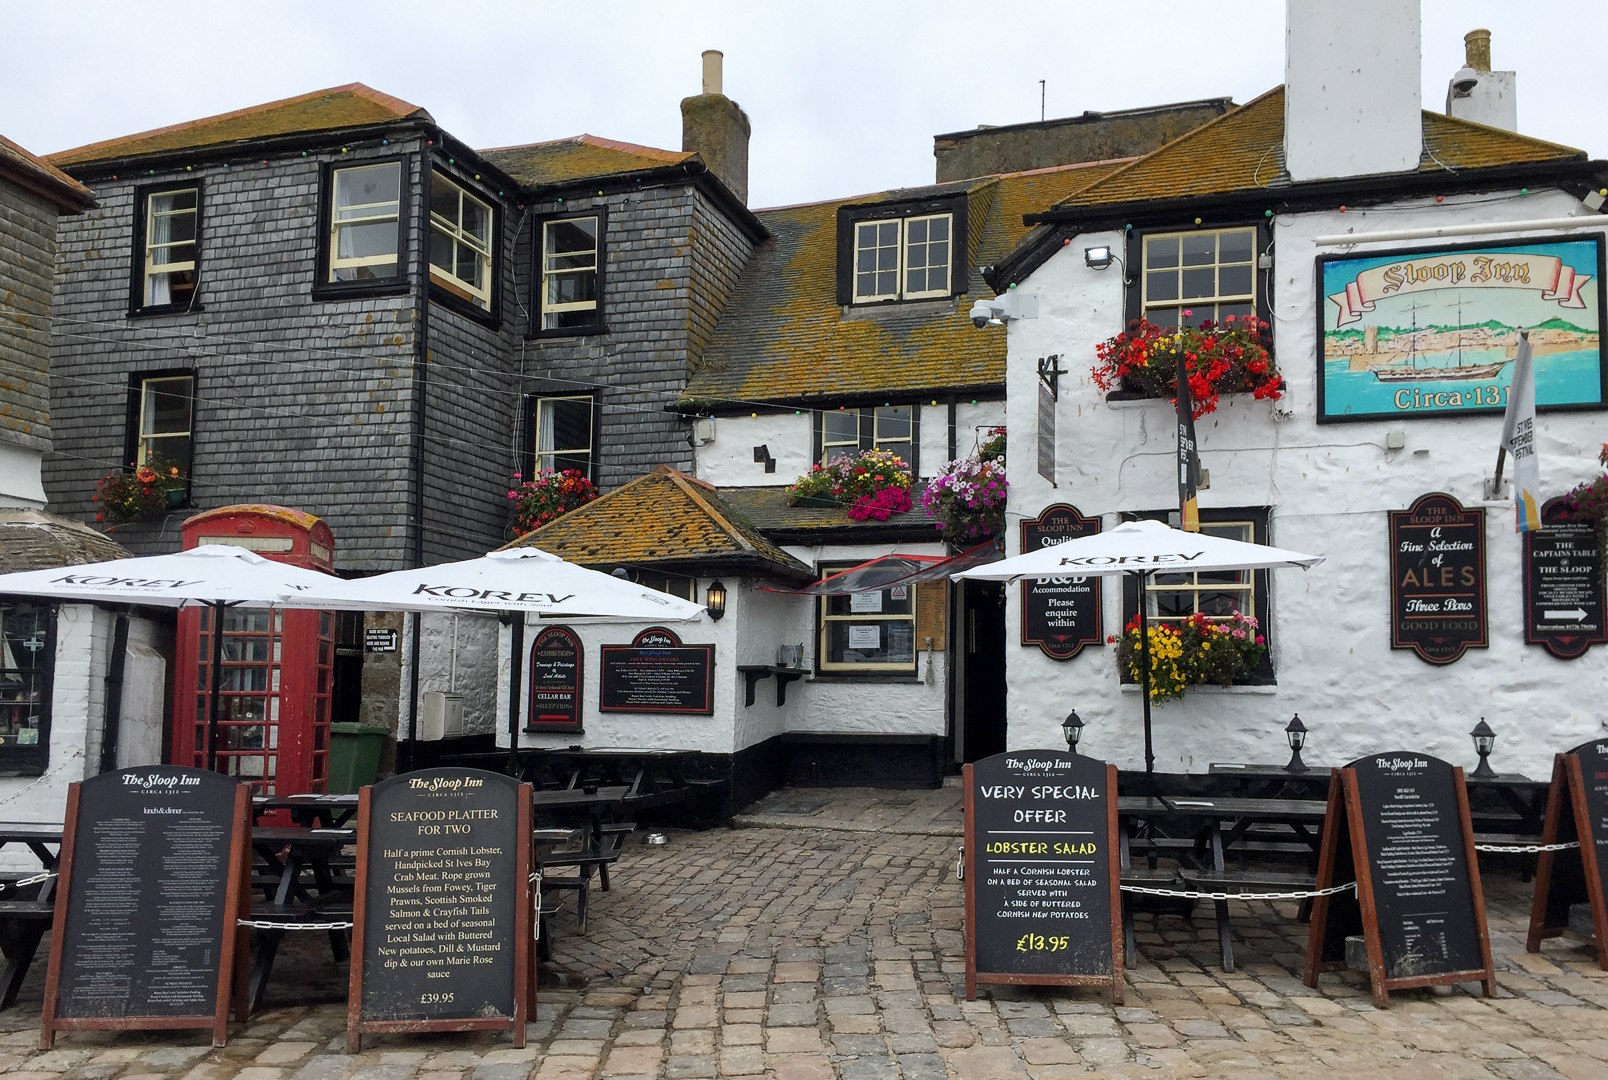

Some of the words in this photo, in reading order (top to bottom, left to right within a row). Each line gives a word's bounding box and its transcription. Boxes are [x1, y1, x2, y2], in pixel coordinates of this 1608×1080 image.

[1383, 257, 1466, 294] Sloop
[1471, 256, 1531, 284] Inn
[1427, 507, 1447, 515] THE
[1410, 516, 1442, 524] SLOOP
[1430, 527, 1441, 538] A
[1400, 541, 1424, 552] Fine
[1428, 540, 1474, 551] Selection
[1059, 551, 1205, 566] KOREV
[1431, 554, 1444, 567] of
[48, 574, 206, 588] KOREV
[1401, 566, 1475, 587] ALES
[412, 583, 576, 603] KOREV
[1048, 599, 1074, 607] Please
[1406, 600, 1440, 612] Three
[1443, 598, 1472, 611] Bars
[1045, 609, 1077, 619] enquire
[1048, 619, 1075, 627] within
[1401, 621, 1438, 630] GOOD
[1442, 621, 1478, 630] FOOD
[1006, 759, 1024, 768] The
[1024, 759, 1052, 771] Sloop
[1054, 759, 1072, 768] Inn
[1376, 758, 1391, 768] The
[1391, 758, 1413, 771] Sloop
[1414, 758, 1427, 767] Inn
[122, 774, 143, 785] The
[143, 774, 178, 788] Sloop
[179, 775, 200, 785] Inn
[409, 778, 429, 788] The
[429, 777, 462, 791] Sloop
[463, 777, 483, 787] Inn
[981, 785, 1025, 799] VERY
[1031, 785, 1099, 800] SPECIAL
[391, 811, 445, 822] SEAFOOD
[448, 810, 498, 820] PLATTER
[1013, 810, 1067, 823] OFFER
[418, 825, 440, 835] FOR
[444, 825, 471, 834] TWO
[384, 849, 403, 858] Half
[411, 849, 434, 858] prime
[436, 847, 468, 856] Cornish
[471, 846, 502, 855] Lobster,
[986, 842, 1048, 854] LOBSTER
[1054, 842, 1096, 855] SALAD
[395, 860, 443, 870] Handpicked
[445, 860, 454, 868] St
[456, 859, 473, 867] Ives
[475, 859, 491, 869] Bay
[394, 873, 414, 882] Crab
[416, 872, 439, 880] Meat.
[442, 872, 463, 881] Rope
[464, 871, 490, 880] grown
[1020, 867, 1054, 875] CORNISH
[1057, 868, 1090, 876] LOBSTER
[387, 885, 420, 894] Mussels
[422, 884, 442, 892] from
[444, 883, 473, 893] Fowey,
[475, 882, 497, 892] Tiger
[1000, 878, 1005, 886] A
[1017, 889, 1047, 897] SERVED
[390, 897, 422, 906] Prawns,
[425, 895, 458, 904] Scottish
[460, 894, 492, 903] Smoked
[1042, 900, 1081, 908] BUTTERED
[390, 909, 420, 918] Salmon
[433, 907, 468, 918] Crayfish
[470, 906, 489, 915] Tails
[1032, 911, 1048, 919] NEW
[385, 922, 412, 931] served
[433, 920, 448, 928] bed
[451, 919, 460, 928] of
[461, 918, 495, 927] seasonal
[387, 933, 411, 942] Local
[413, 933, 435, 942] Salad
[438, 932, 456, 940] with
[458, 931, 492, 939] Buttered
[1016, 933, 1069, 952] £13.95
[378, 946, 398, 955] New
[400, 945, 435, 956] potatoes,
[439, 944, 454, 953] Dill
[456, 944, 465, 952] &
[467, 942, 500, 951] Mustard
[384, 959, 397, 968] dip
[400, 959, 408, 967] &
[446, 956, 471, 965] Marie
[473, 955, 493, 964] Rose
[427, 970, 450, 979] sauce
[421, 993, 454, 1004] £39.95
